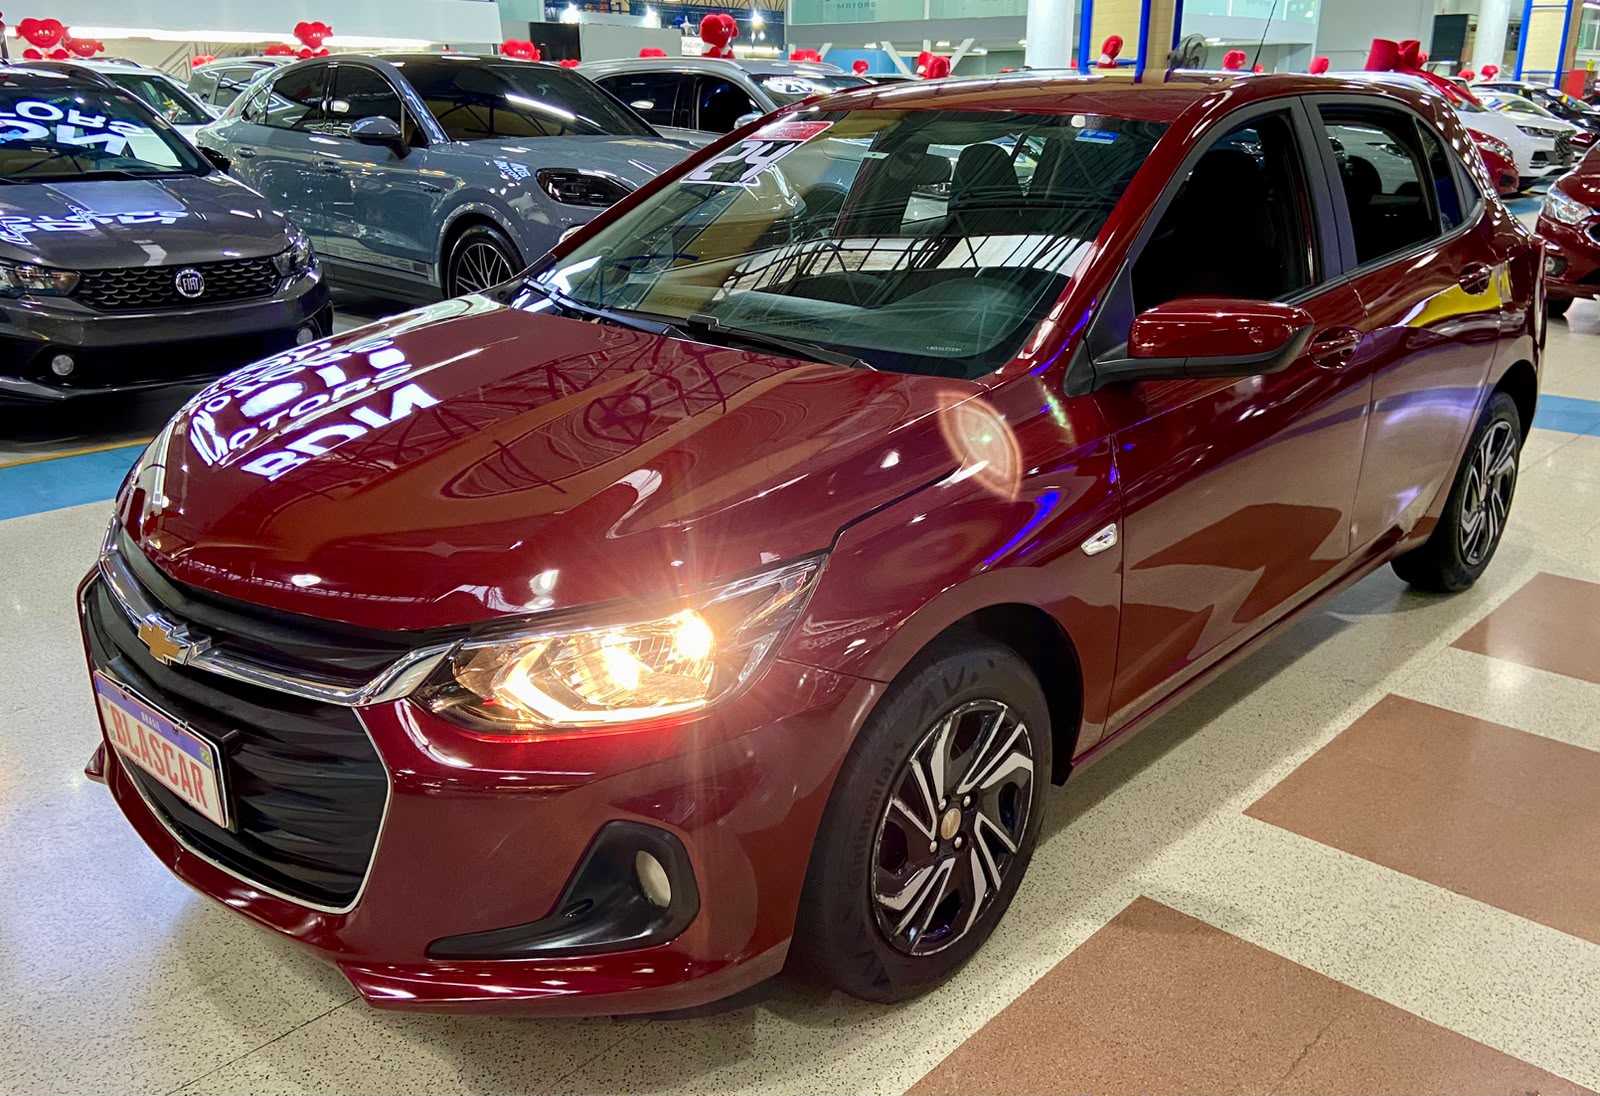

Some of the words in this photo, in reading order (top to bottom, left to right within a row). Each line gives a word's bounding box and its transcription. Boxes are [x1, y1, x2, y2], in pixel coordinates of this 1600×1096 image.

[688, 141, 796, 182] 24
[182, 277, 199, 291] FIAT
[140, 711, 162, 733] BRASIL
[110, 705, 209, 809] BLASCAR
